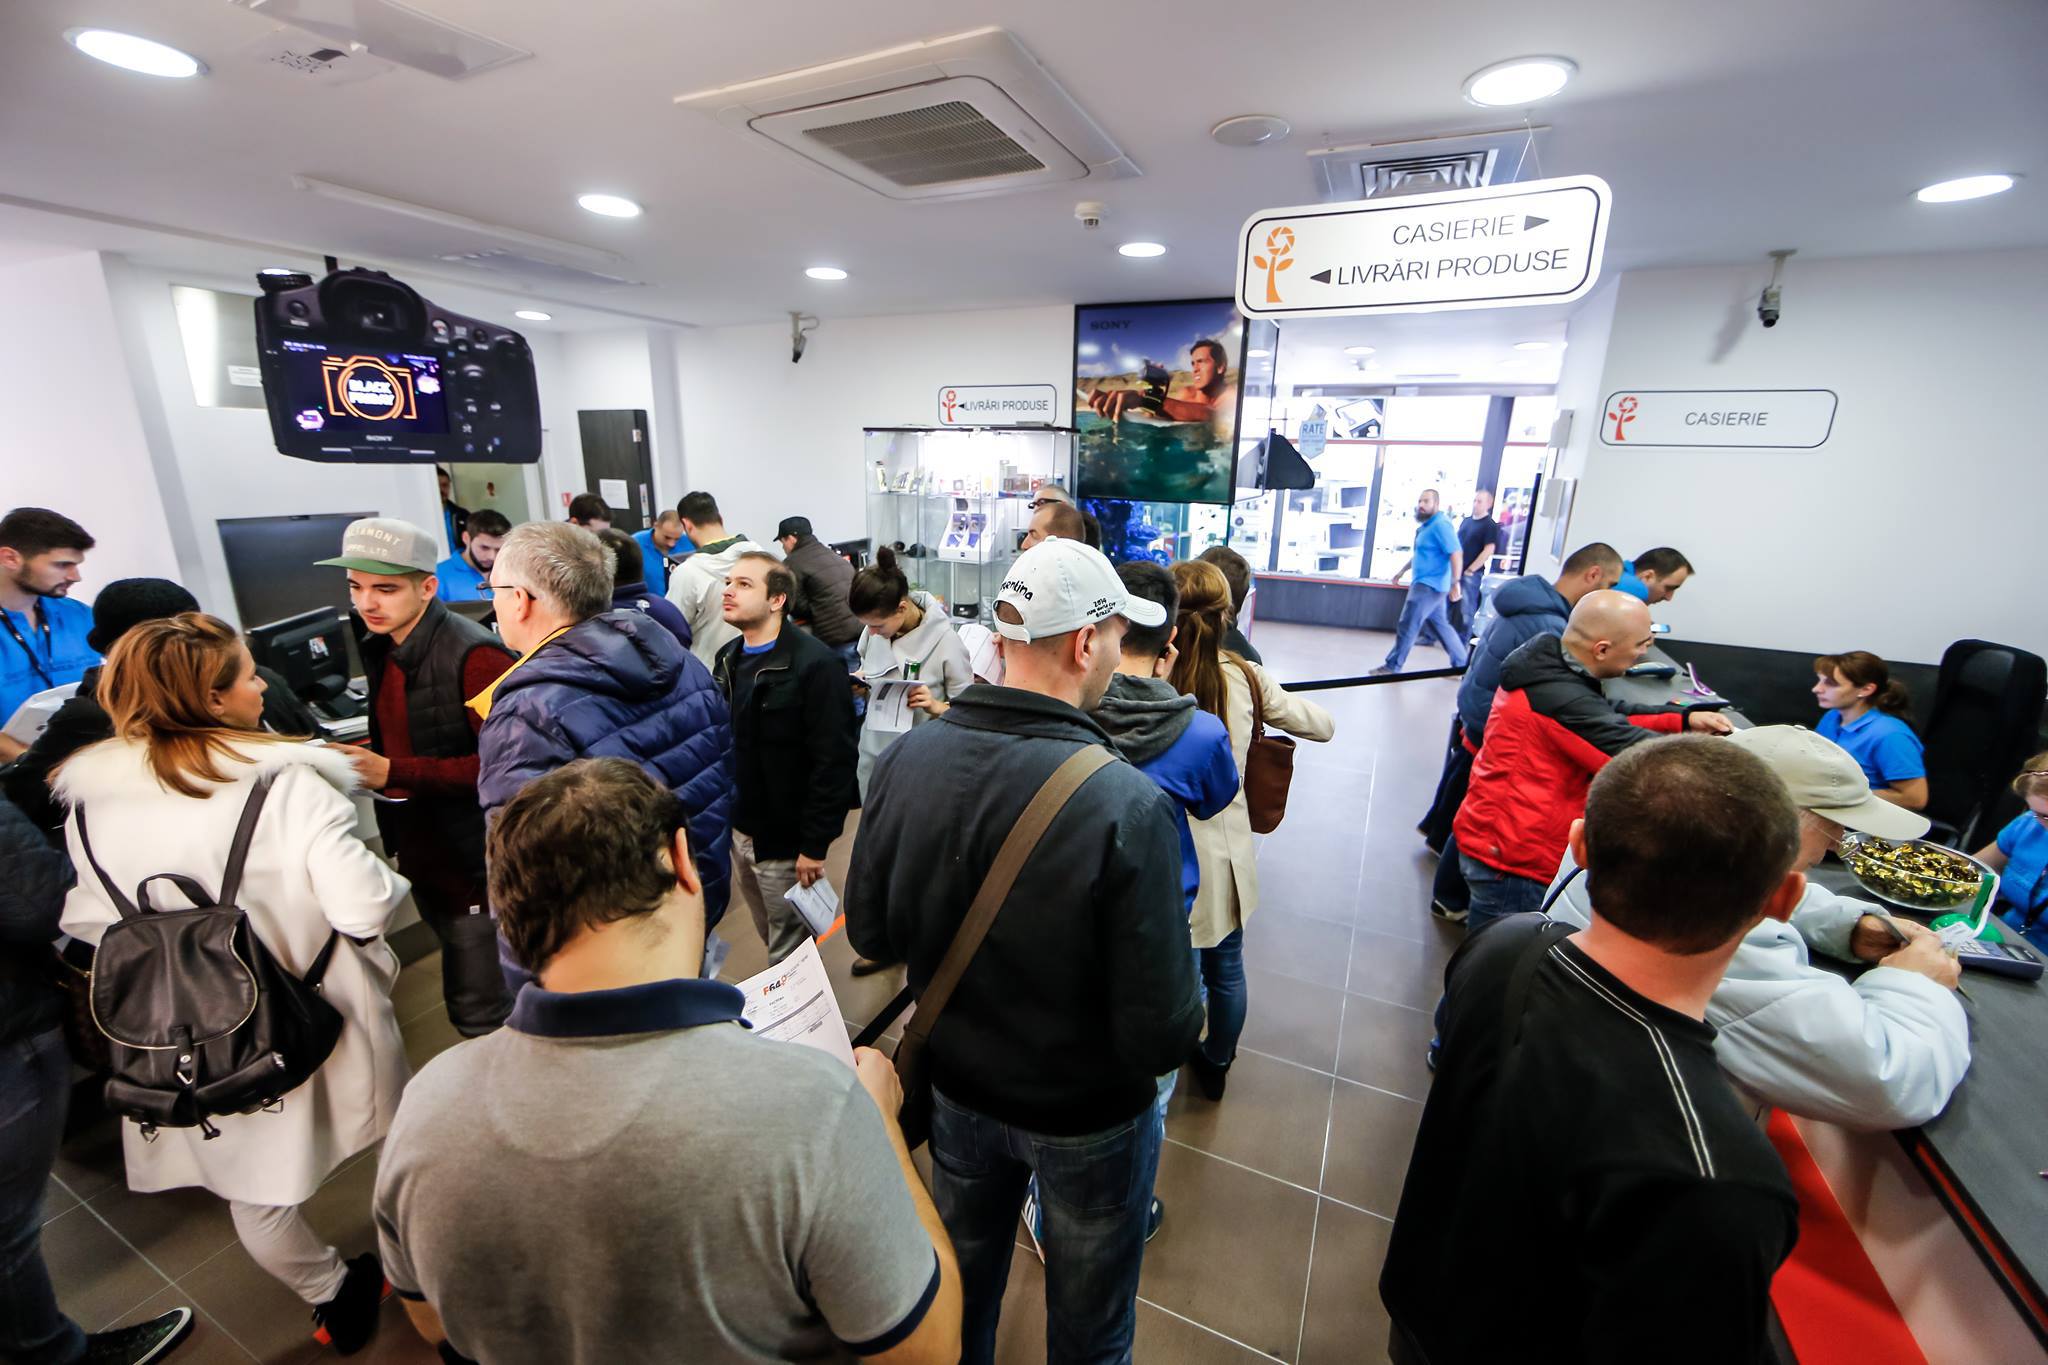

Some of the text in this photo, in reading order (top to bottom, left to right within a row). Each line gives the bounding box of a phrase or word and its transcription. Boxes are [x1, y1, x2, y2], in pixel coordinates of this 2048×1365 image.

[1393, 215, 1516, 245] CASIERIE
[1337, 249, 1570, 286] LIVRĂRI PRODUSE
[1089, 320, 1131, 330] SONY
[1002, 400, 1049, 411] PRODUSE
[1685, 412, 1769, 426] CASIERIE
[1302, 423, 1325, 434] RATE
[366, 434, 393, 442] SONY
